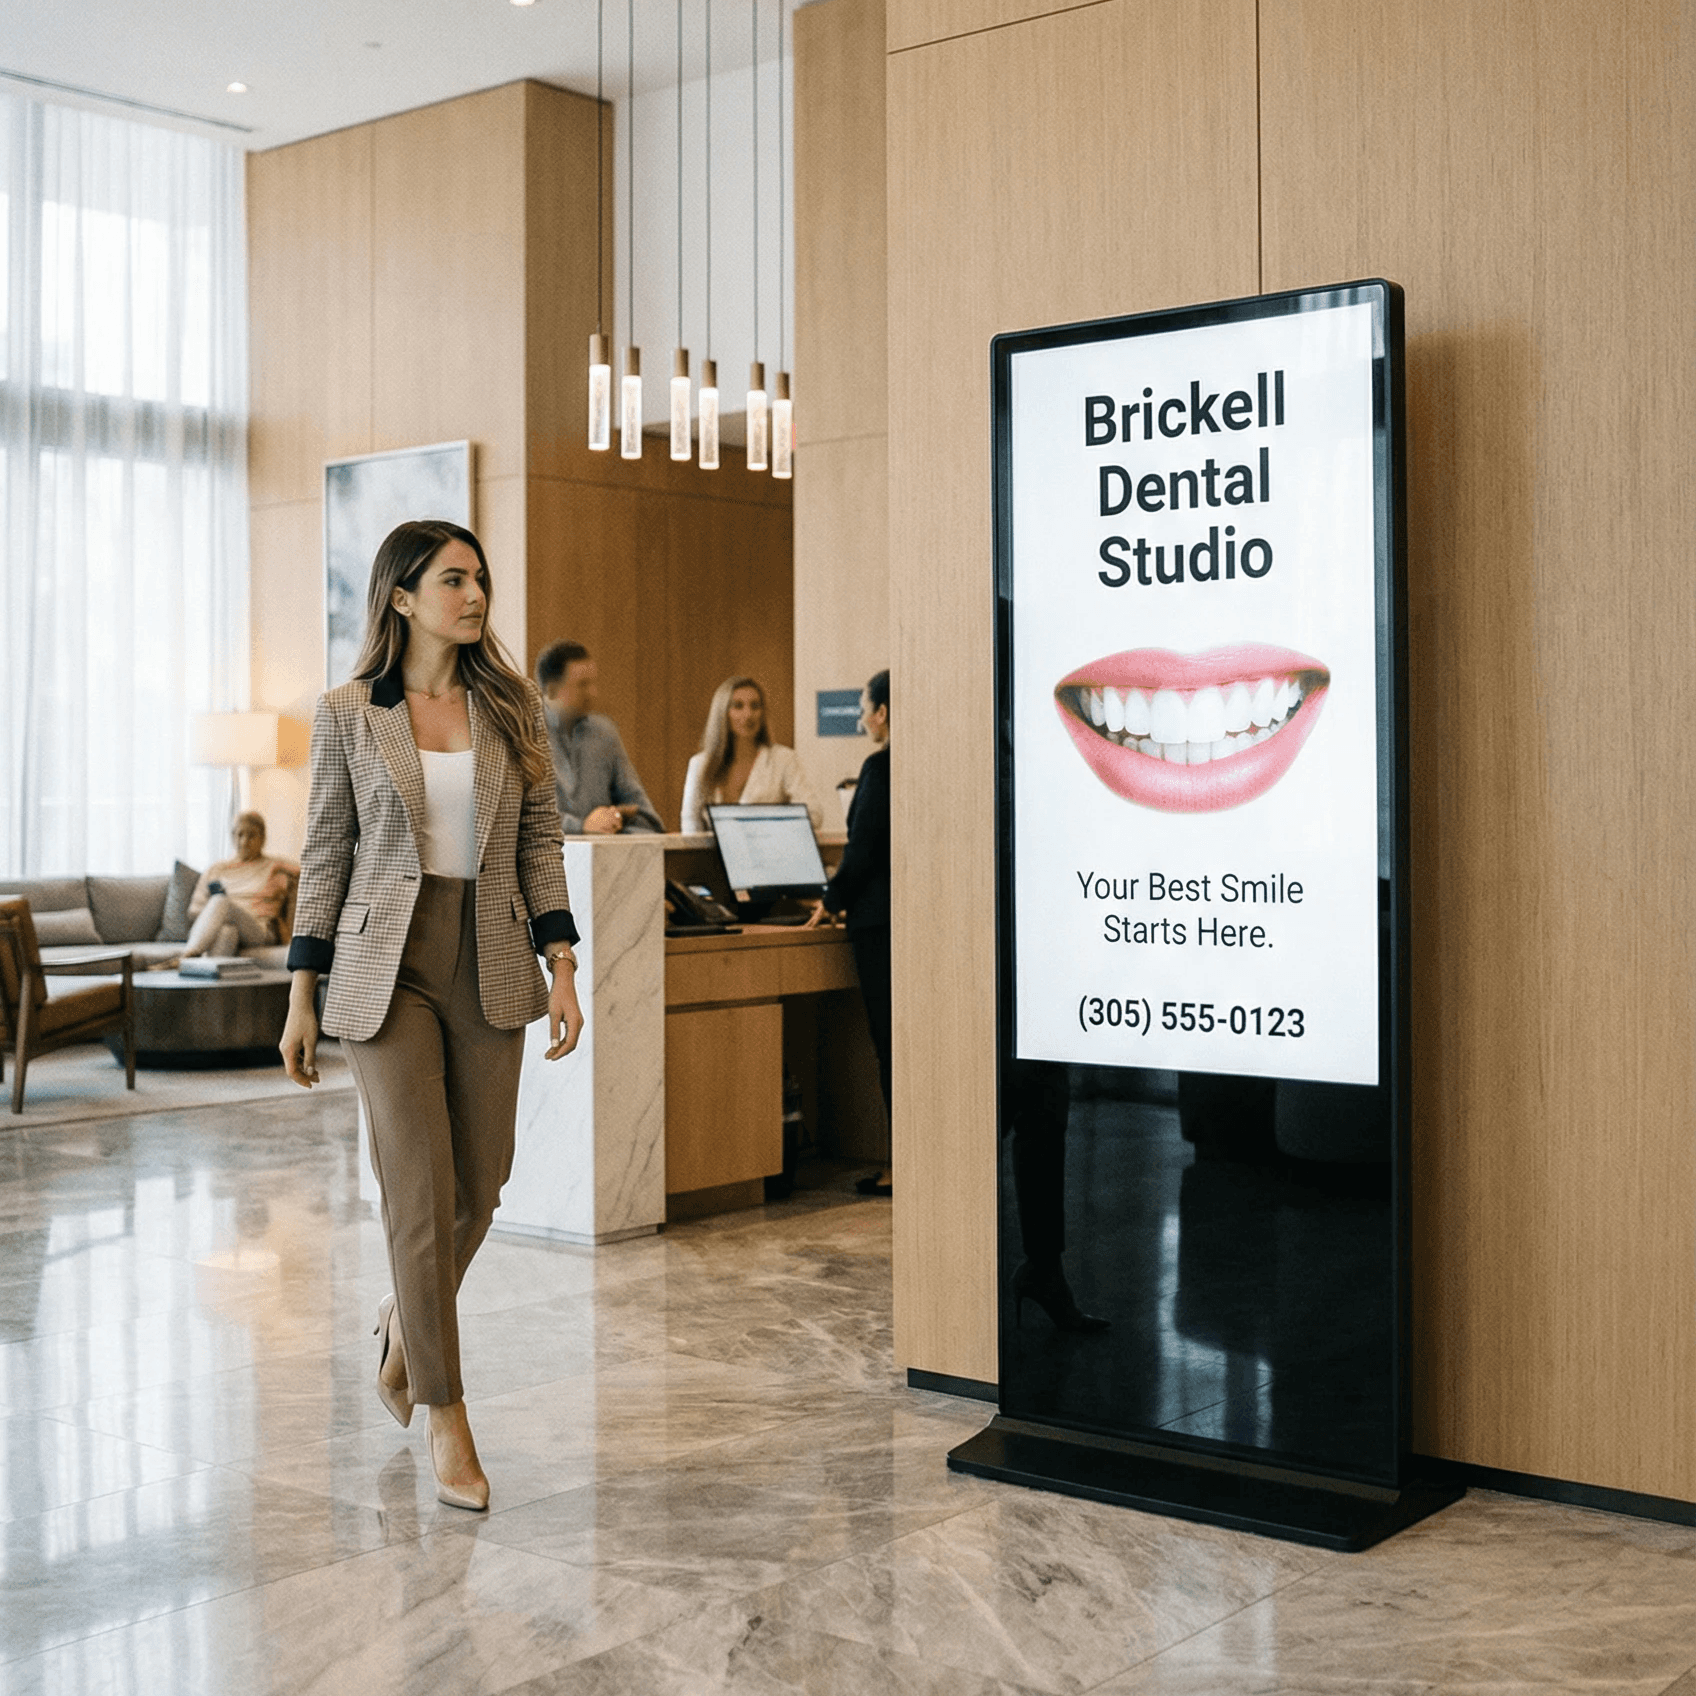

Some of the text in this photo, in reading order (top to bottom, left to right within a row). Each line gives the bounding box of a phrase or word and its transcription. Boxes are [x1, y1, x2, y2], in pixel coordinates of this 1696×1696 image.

[1084, 369, 1286, 447] Brickell
[1098, 446, 1271, 517] Dental
[1098, 525, 1273, 588] Studio
[1076, 870, 1304, 904] Your Best Smile
[1103, 914, 1274, 949] Starts Here.
[1078, 994, 1305, 1039] (305) 555-0123
